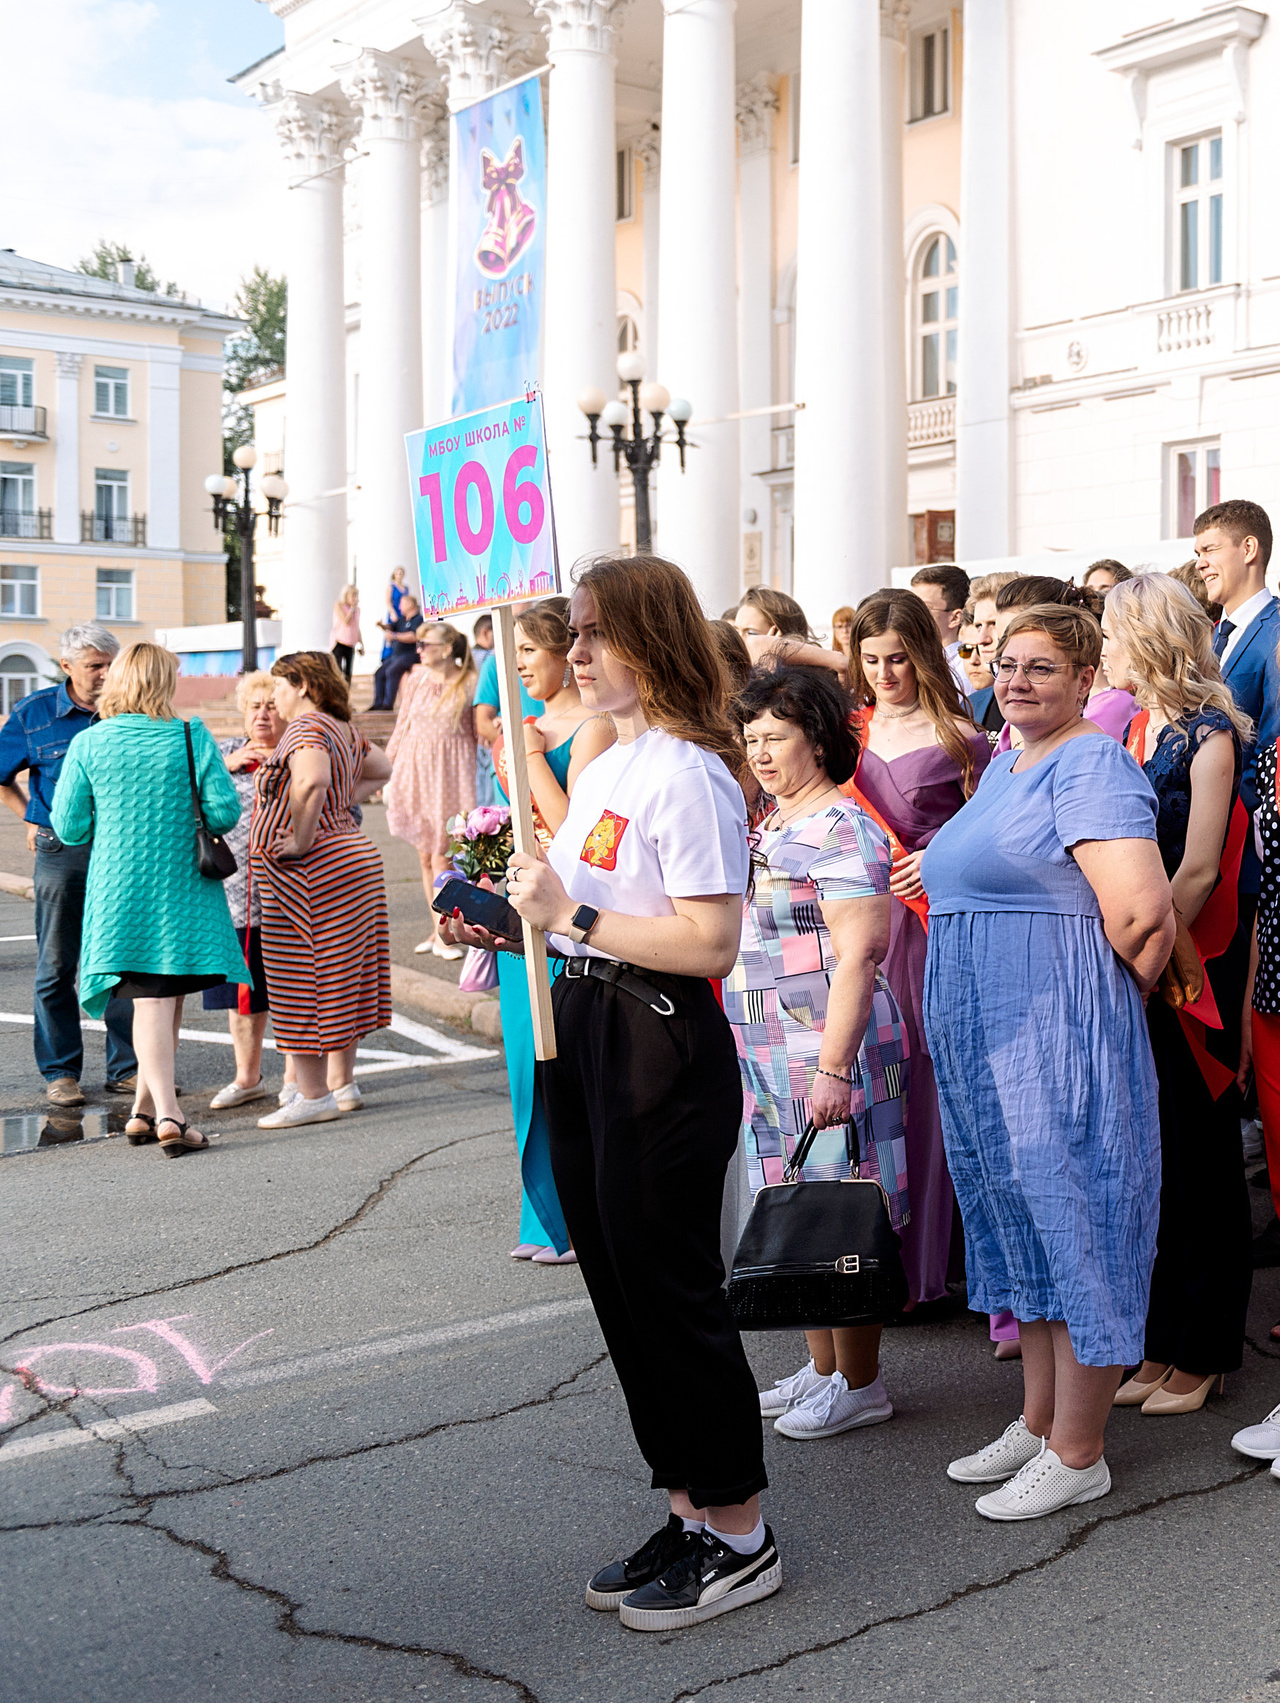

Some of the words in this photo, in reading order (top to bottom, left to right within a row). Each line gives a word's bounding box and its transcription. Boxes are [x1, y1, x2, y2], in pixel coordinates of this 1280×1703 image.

[474, 273, 534, 311] ВЫПУСК
[482, 303, 518, 334] 2022
[429, 434, 460, 459] МБОУ
[465, 421, 510, 448] ШКОЛА
[513, 415, 526, 433] №
[419, 444, 545, 564] 106
